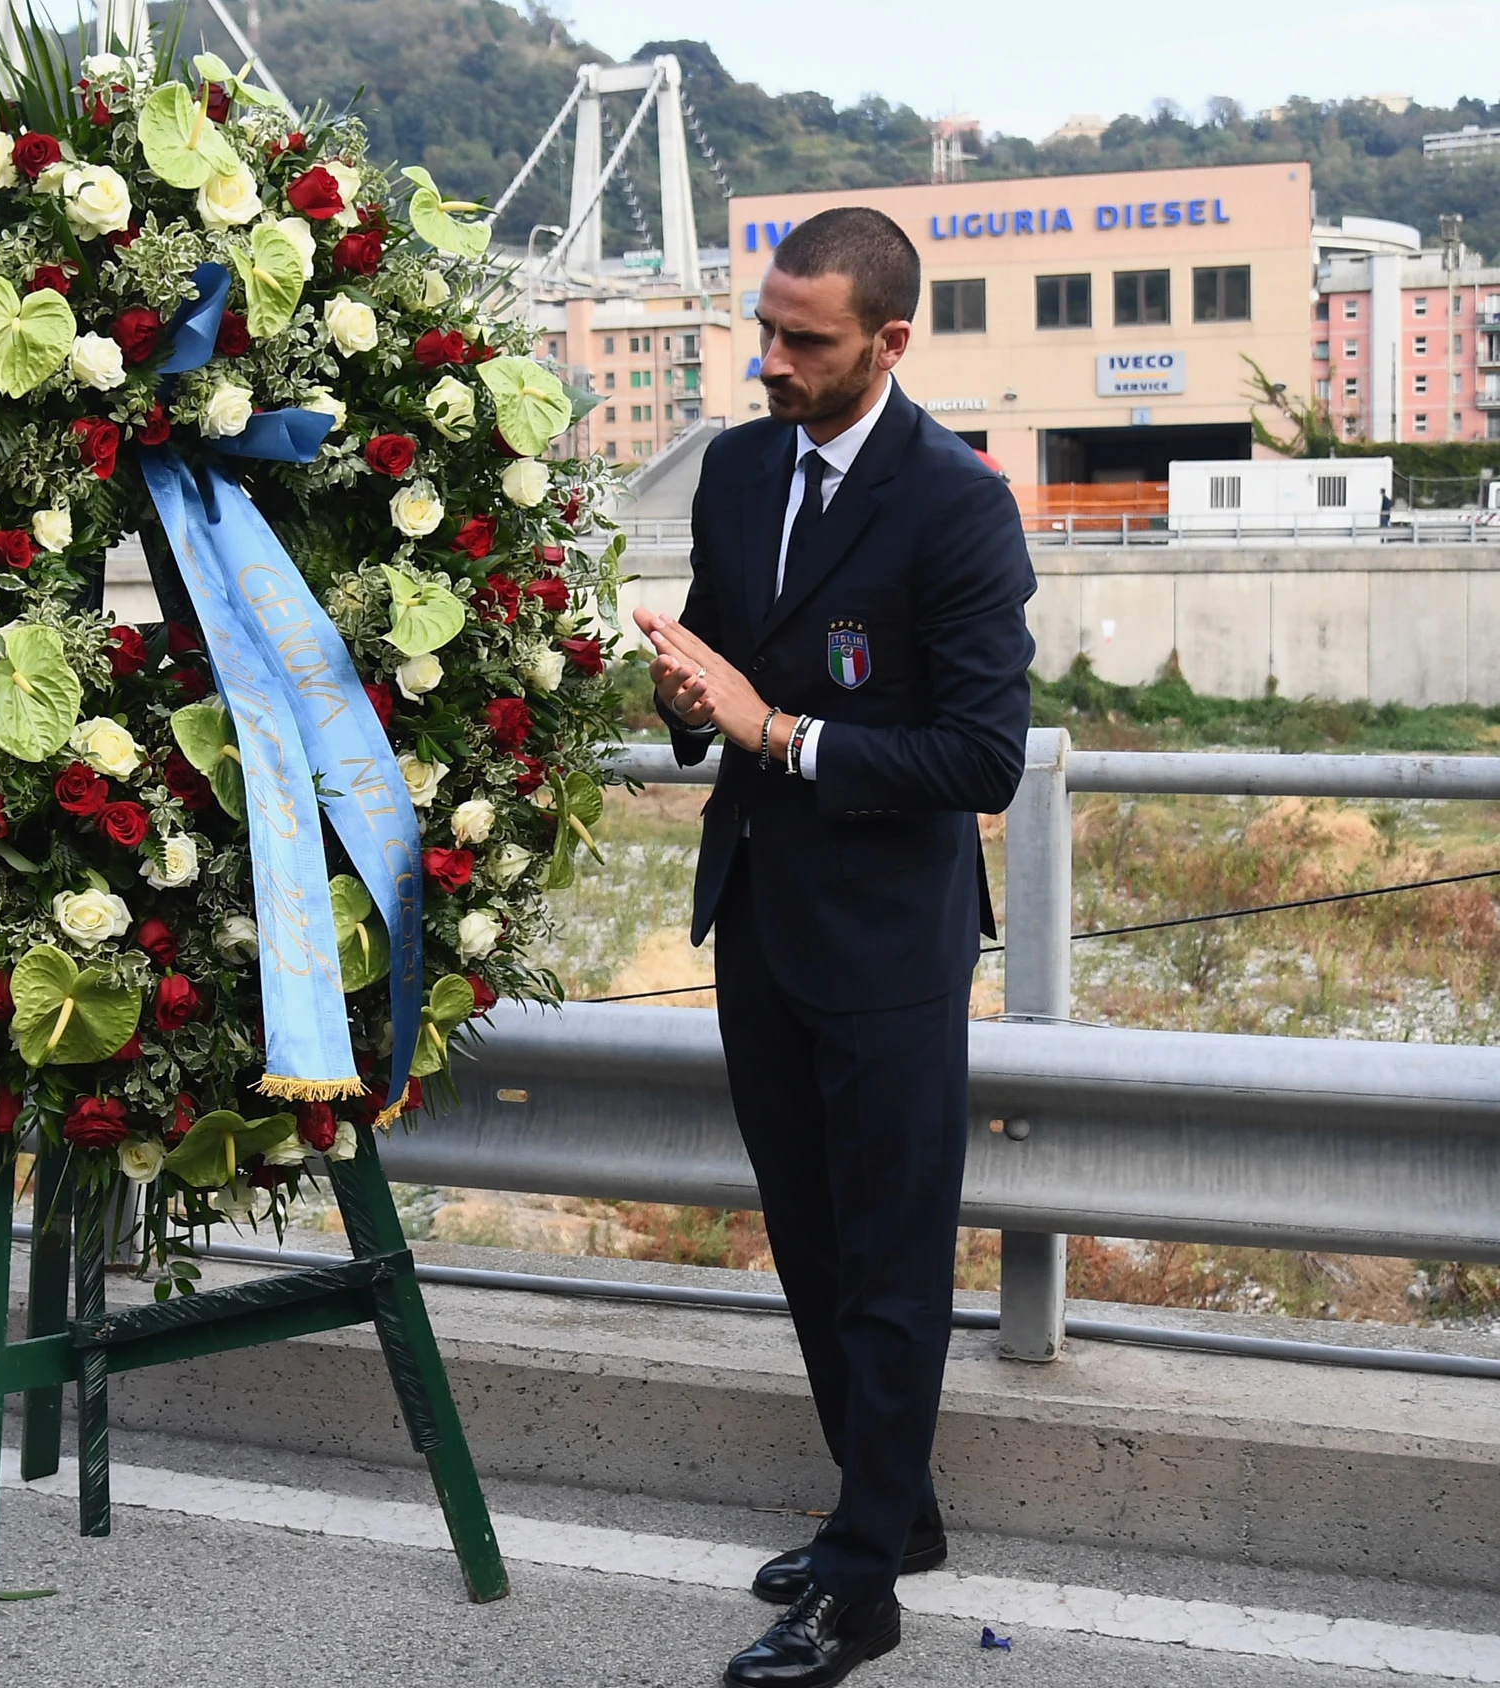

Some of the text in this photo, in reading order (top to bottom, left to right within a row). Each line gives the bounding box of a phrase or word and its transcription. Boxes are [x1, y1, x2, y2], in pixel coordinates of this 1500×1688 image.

[930, 198, 1230, 240] LIGURIA DIESEL
[745, 219, 806, 252] IV
[1109, 354, 1173, 370] IVECO
[1114, 382, 1168, 392] SERVICE
[831, 635, 863, 646] ITALIA
[237, 563, 348, 729] GENOVA
[339, 758, 397, 832] NEL
